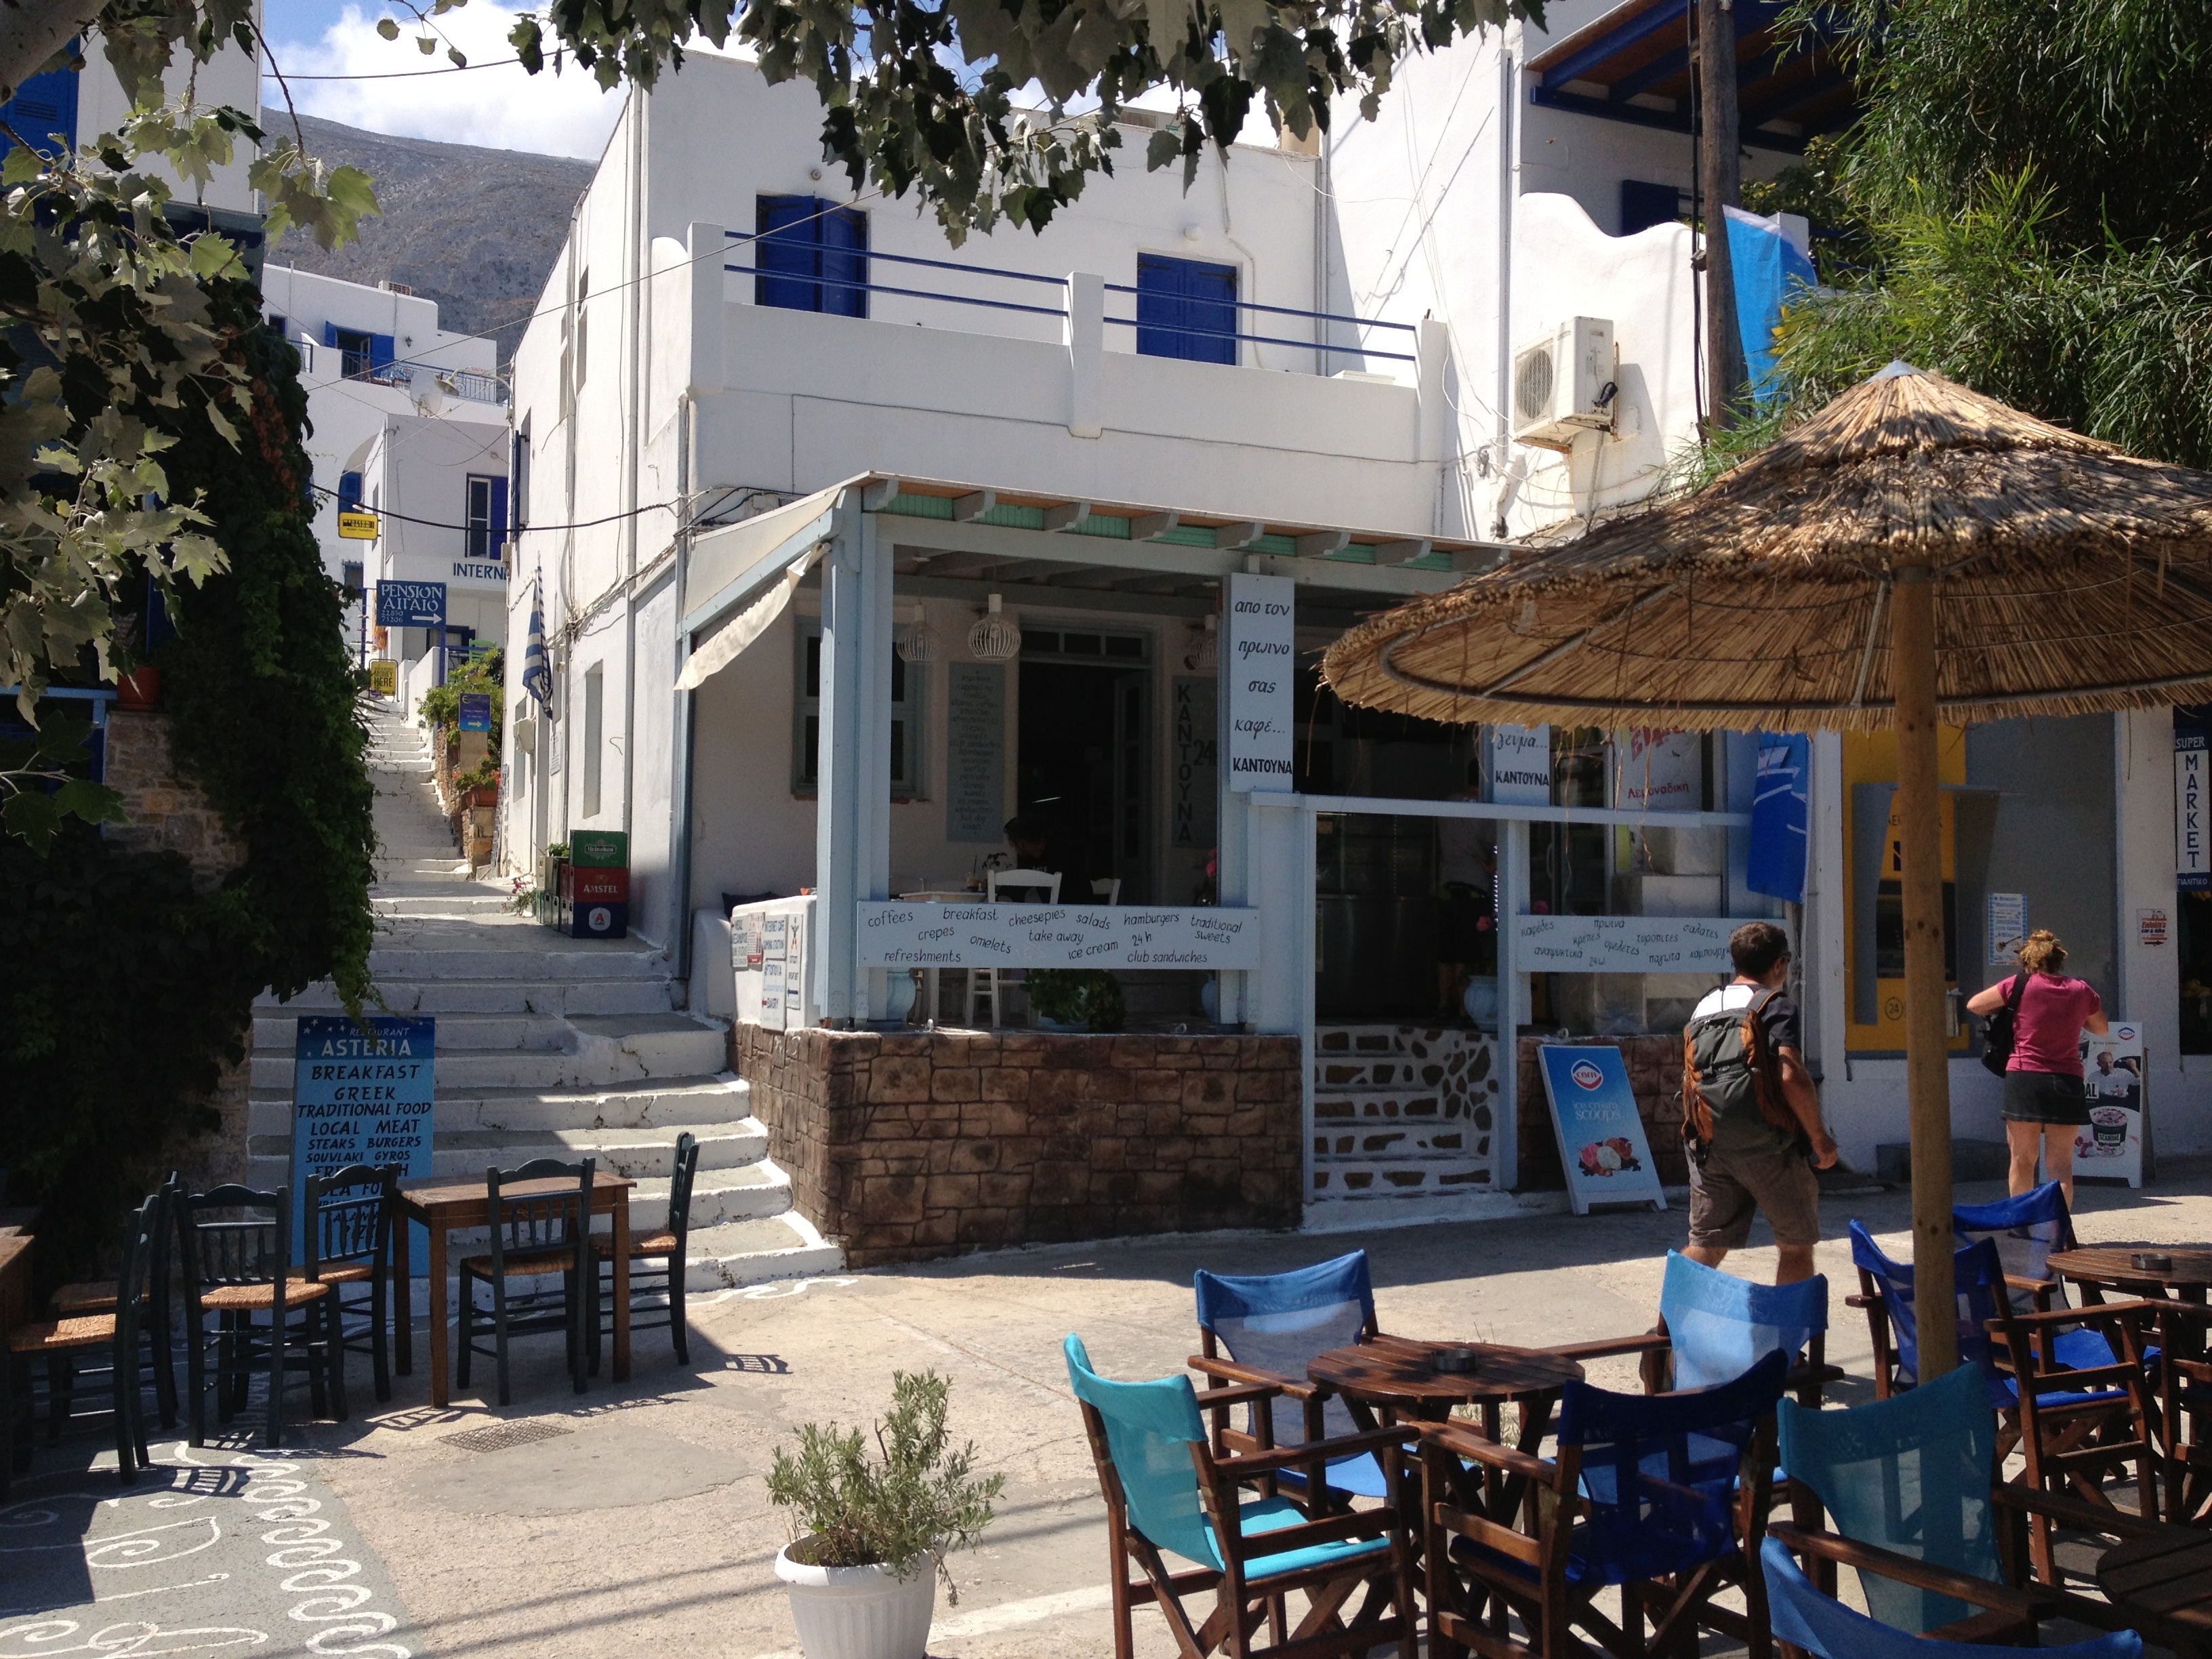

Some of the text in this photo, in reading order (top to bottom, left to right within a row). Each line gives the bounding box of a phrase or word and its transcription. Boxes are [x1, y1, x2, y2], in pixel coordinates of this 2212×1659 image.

[381, 584, 442, 600] PENSION
[1265, 603, 1290, 615] τον
[2176, 737, 2205, 749] SUPER
[1233, 758, 1292, 774] ΚΑΝΤΟΥΝΑ
[1496, 770, 1549, 786] ΚΑΝΤΟΥΝΑ
[2186, 754, 2200, 867] MARKET
[583, 884, 618, 893] AMSTEL
[868, 909, 914, 927] coffees
[943, 907, 998, 920] breakfast
[1009, 909, 1065, 926] cheesepies
[1076, 913, 1111, 930] salads
[1124, 912, 1180, 926] hamburgers
[1191, 915, 1242, 933] traditional
[918, 926, 954, 941] crepes
[1029, 929, 1084, 945] take away
[1194, 930, 1231, 944] sweets
[970, 935, 1012, 954] omelets
[1068, 941, 1119, 960] ice cream
[884, 949, 961, 962] refreshments
[1127, 950, 1208, 963] club sandwiches
[321, 1040, 412, 1056] ASTERIA
[312, 1065, 420, 1080] BREAKFAST
[334, 1086, 396, 1102] GREEK
[298, 1102, 432, 1118] TRADITIONAL FOOD
[310, 1119, 420, 1136] LOCAL MEAT
[308, 1136, 422, 1150] STEAKS BURGERS
[306, 1150, 411, 1163] SOUVLAKI GYROS
